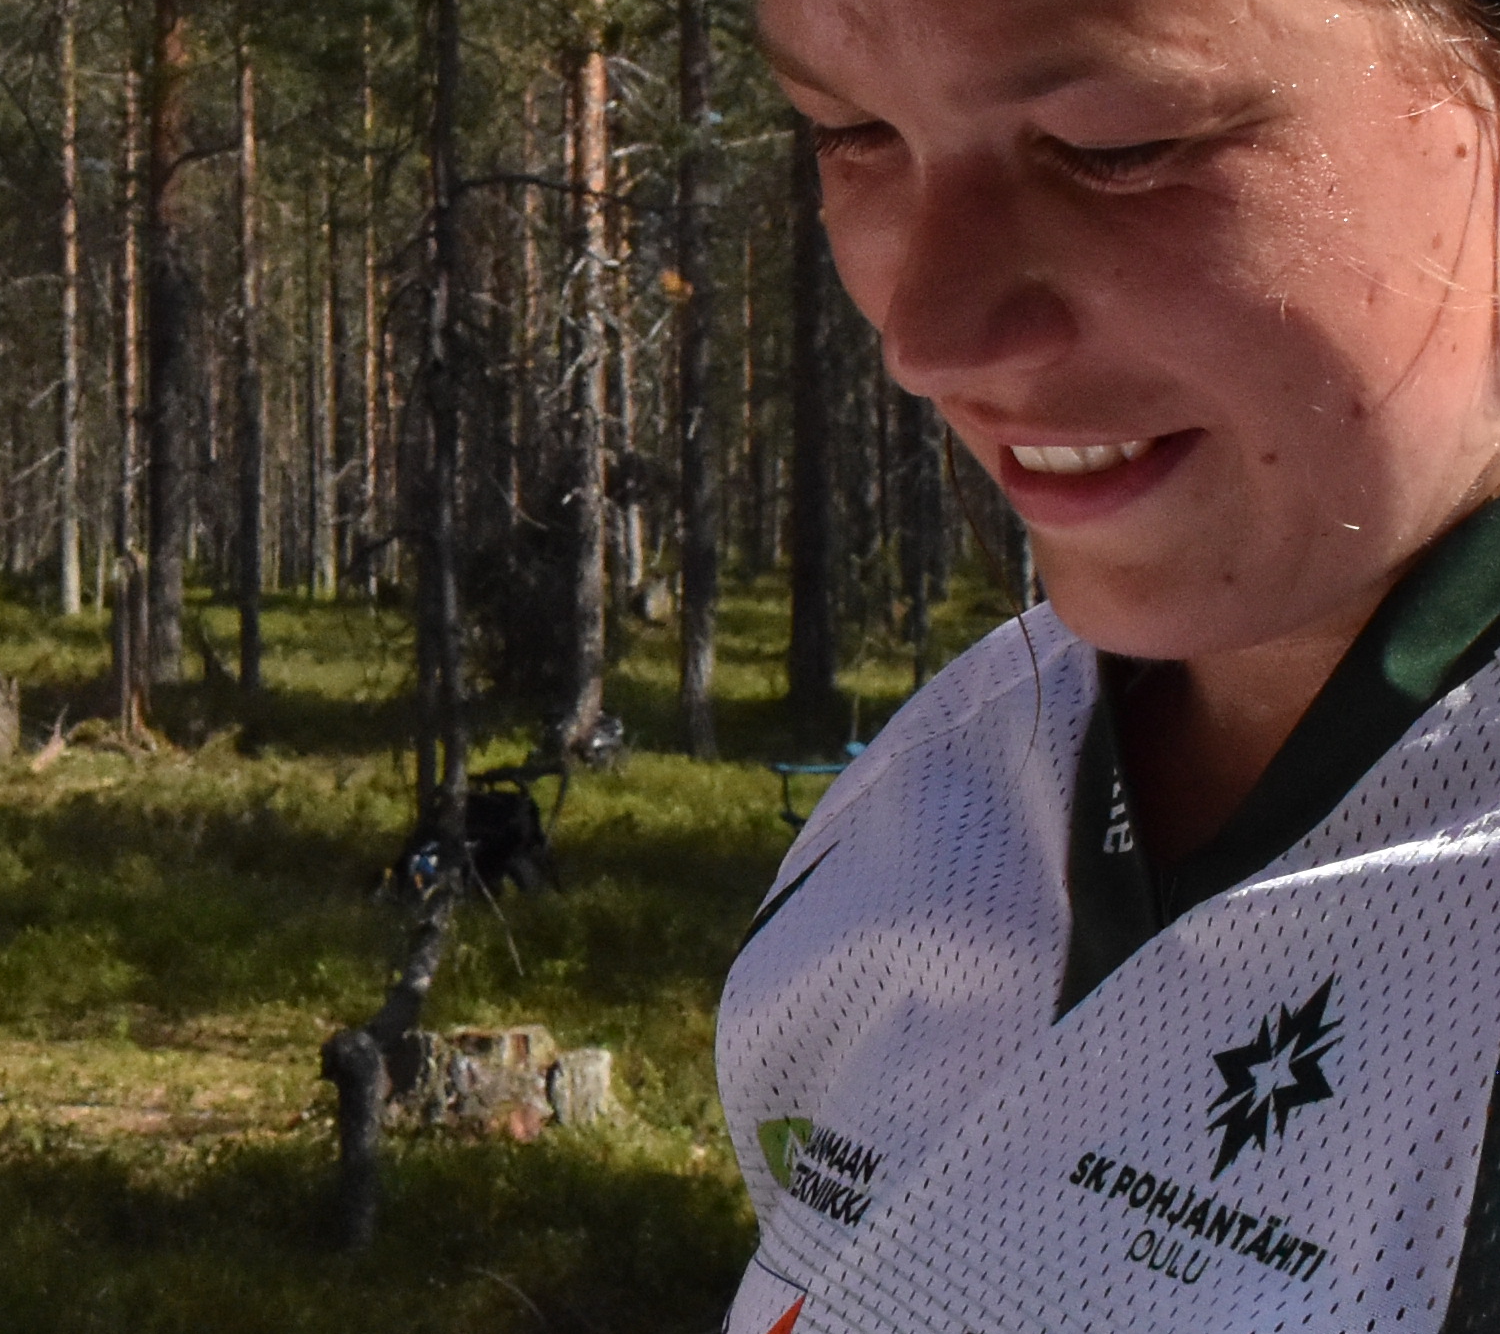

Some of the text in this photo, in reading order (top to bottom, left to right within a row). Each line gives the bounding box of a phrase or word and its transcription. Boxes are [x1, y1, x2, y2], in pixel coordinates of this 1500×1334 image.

[1069, 1152, 1327, 1282] SK POHJANTÄHTI
[1127, 1230, 1211, 1284] OULU
